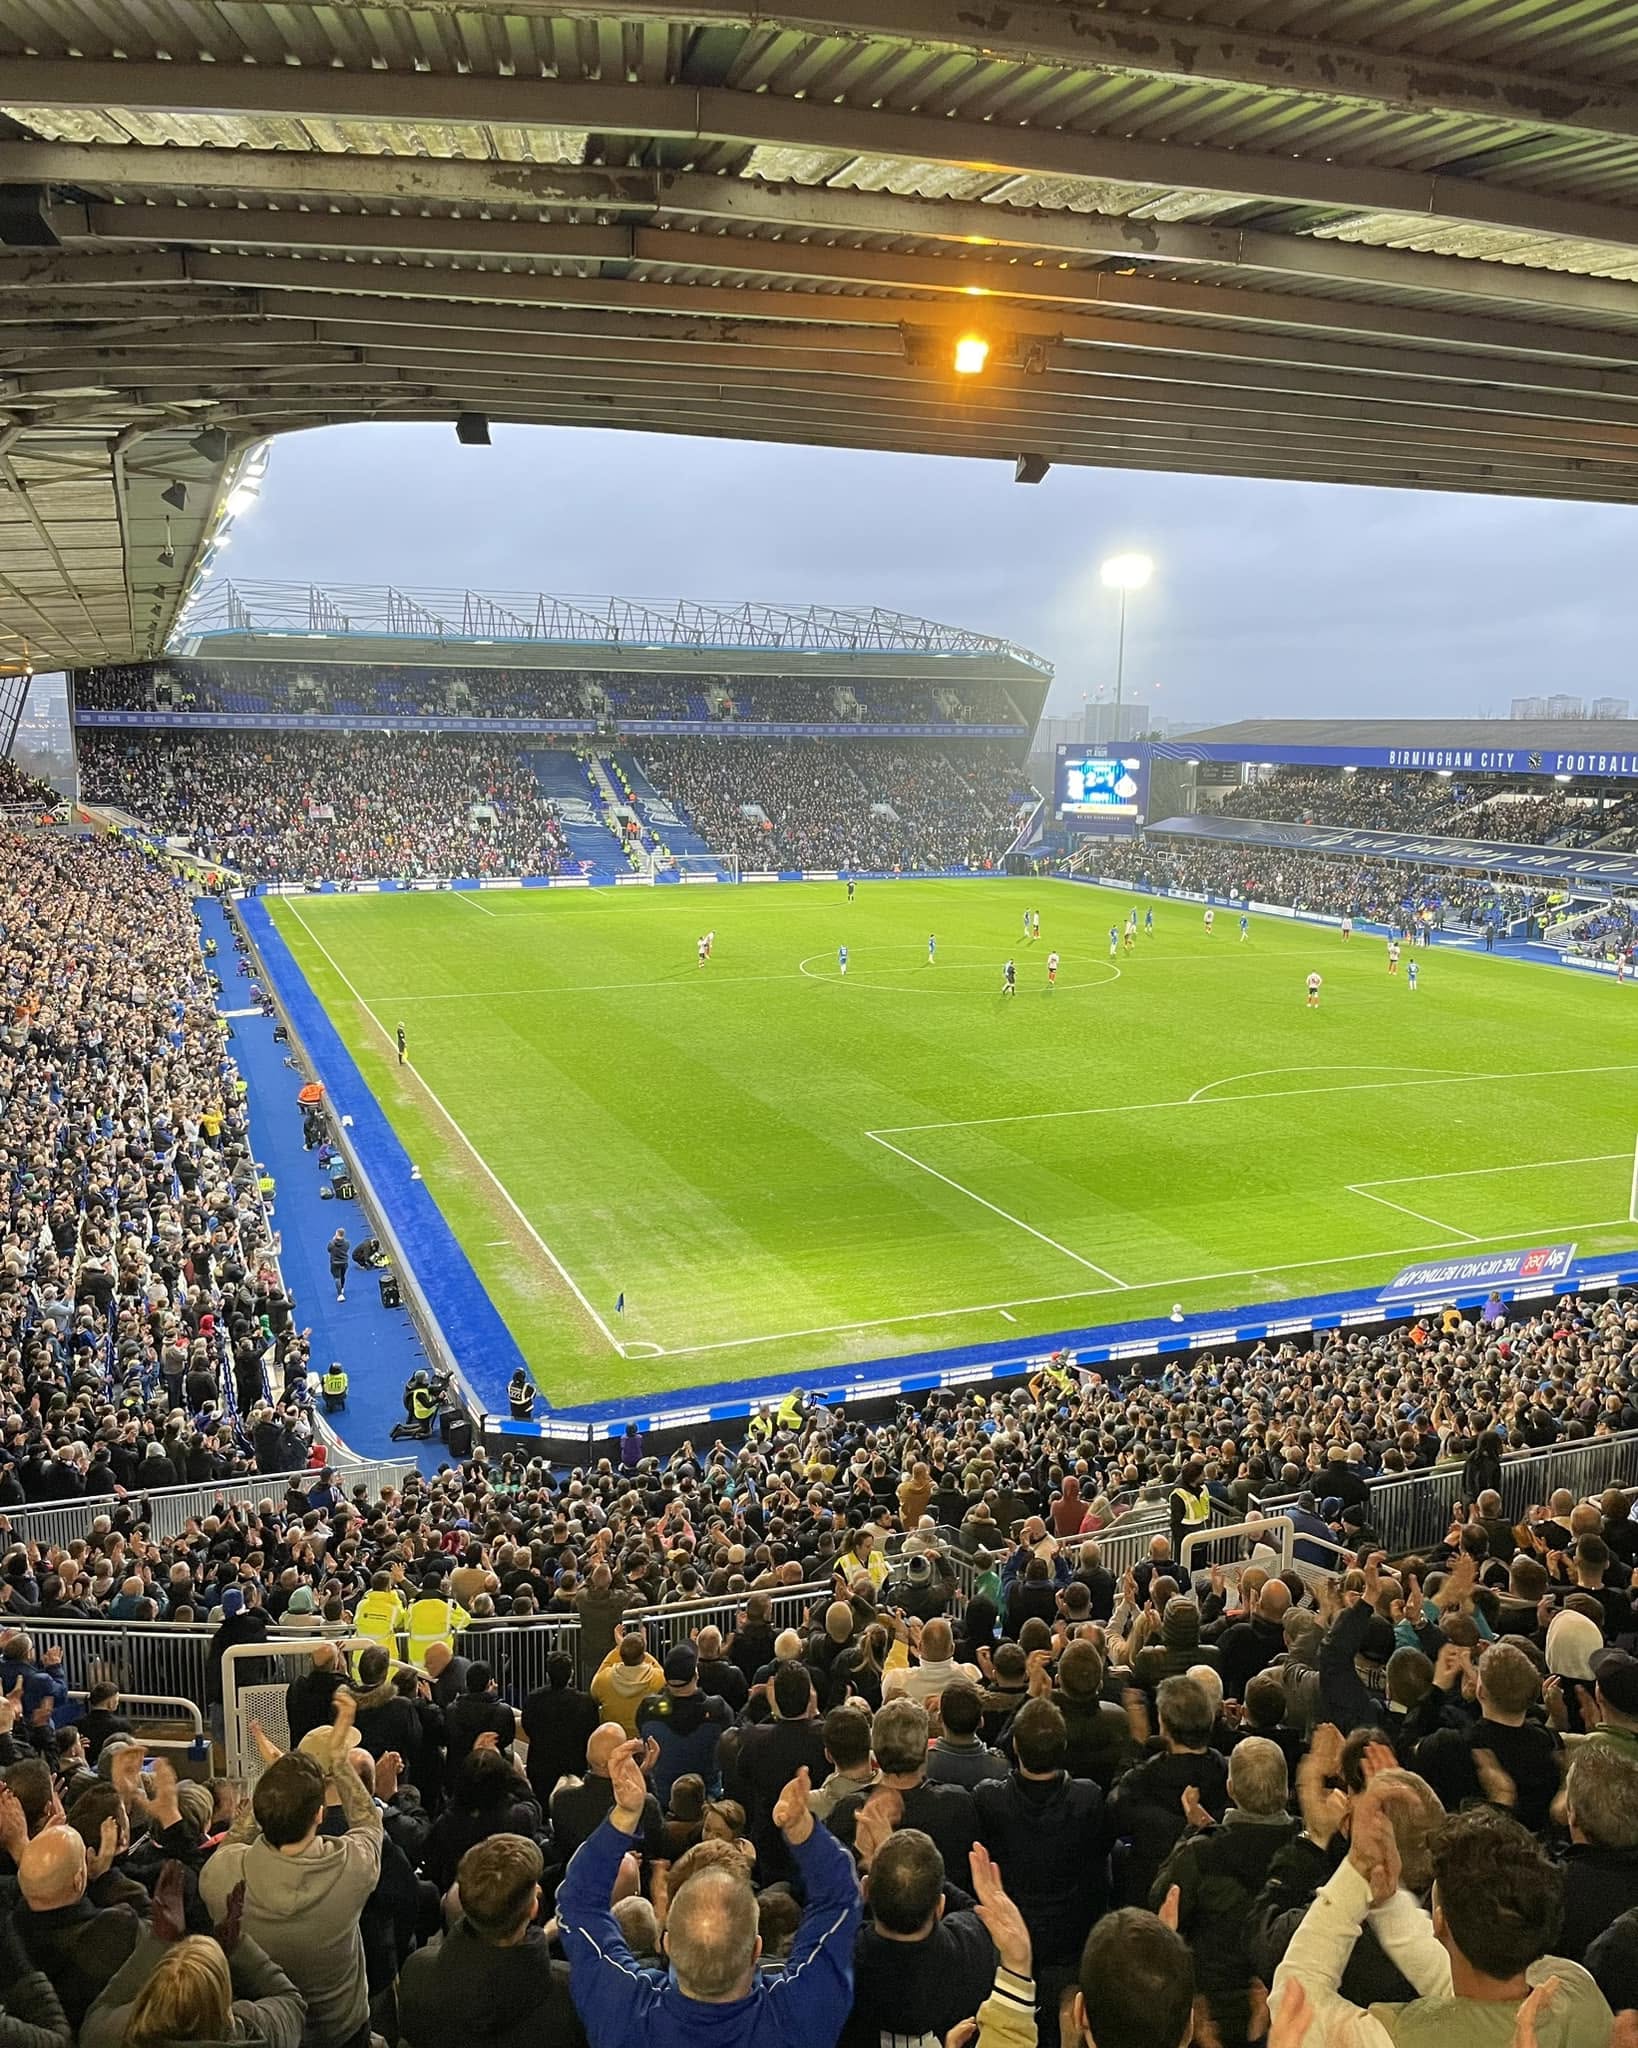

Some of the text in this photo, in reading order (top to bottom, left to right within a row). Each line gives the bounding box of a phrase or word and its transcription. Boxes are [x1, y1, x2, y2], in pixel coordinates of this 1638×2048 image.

[1389, 751, 1638, 773] BIRMINGHAM CITY FOOTBALL
[1350, 835, 1401, 848] we
[1381, 840, 1522, 864] journey
[1518, 855, 1571, 867] on
[1567, 856, 1635, 872] we
[1499, 1257, 1521, 1272] THE
[1524, 1255, 1546, 1271] bet
[1544, 1249, 1566, 1270] sky
